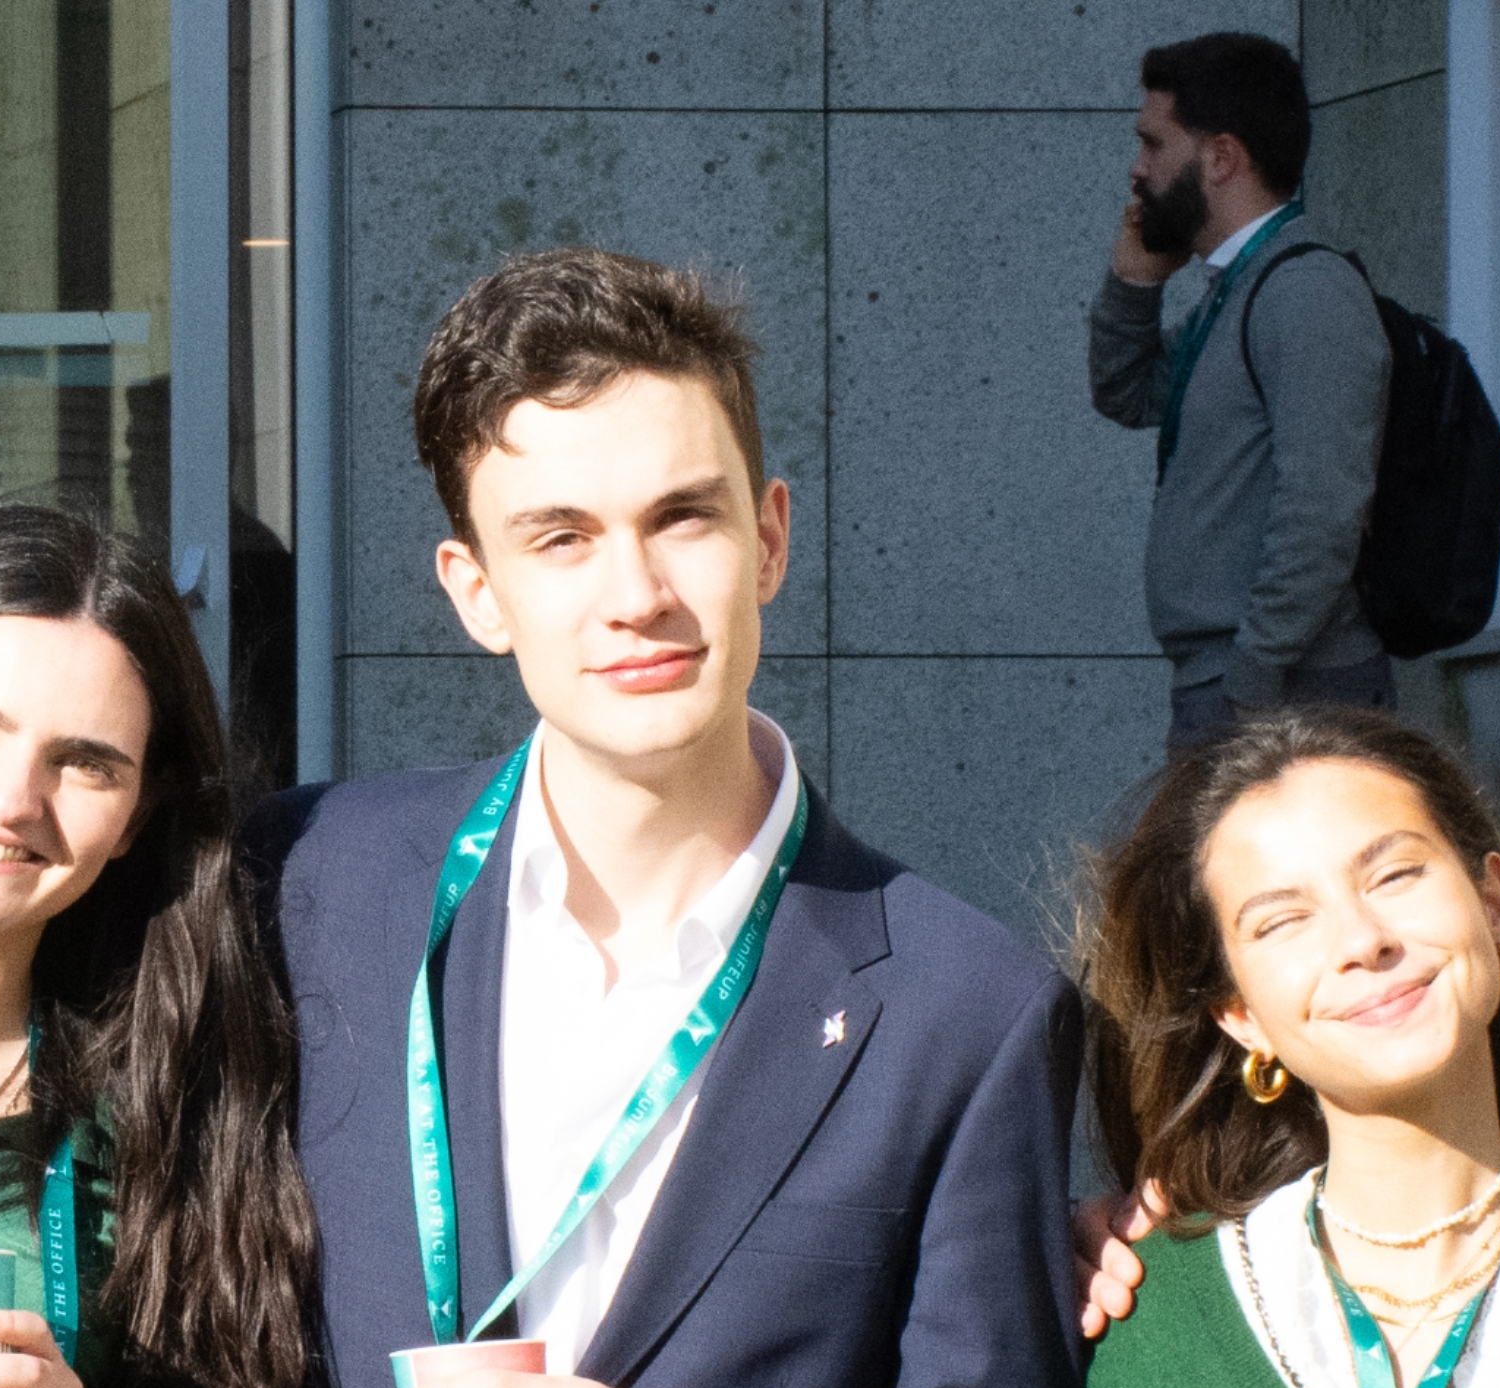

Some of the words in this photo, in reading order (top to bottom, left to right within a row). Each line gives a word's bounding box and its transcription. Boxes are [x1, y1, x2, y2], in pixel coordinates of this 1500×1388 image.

[416, 1052, 430, 1093] DAY
[419, 1105, 434, 1129] AT
[422, 1139, 439, 1181] THE
[48, 1208, 65, 1274] OFFICE
[427, 1189, 446, 1266] OFFICE
[53, 1280, 67, 1317] THE
